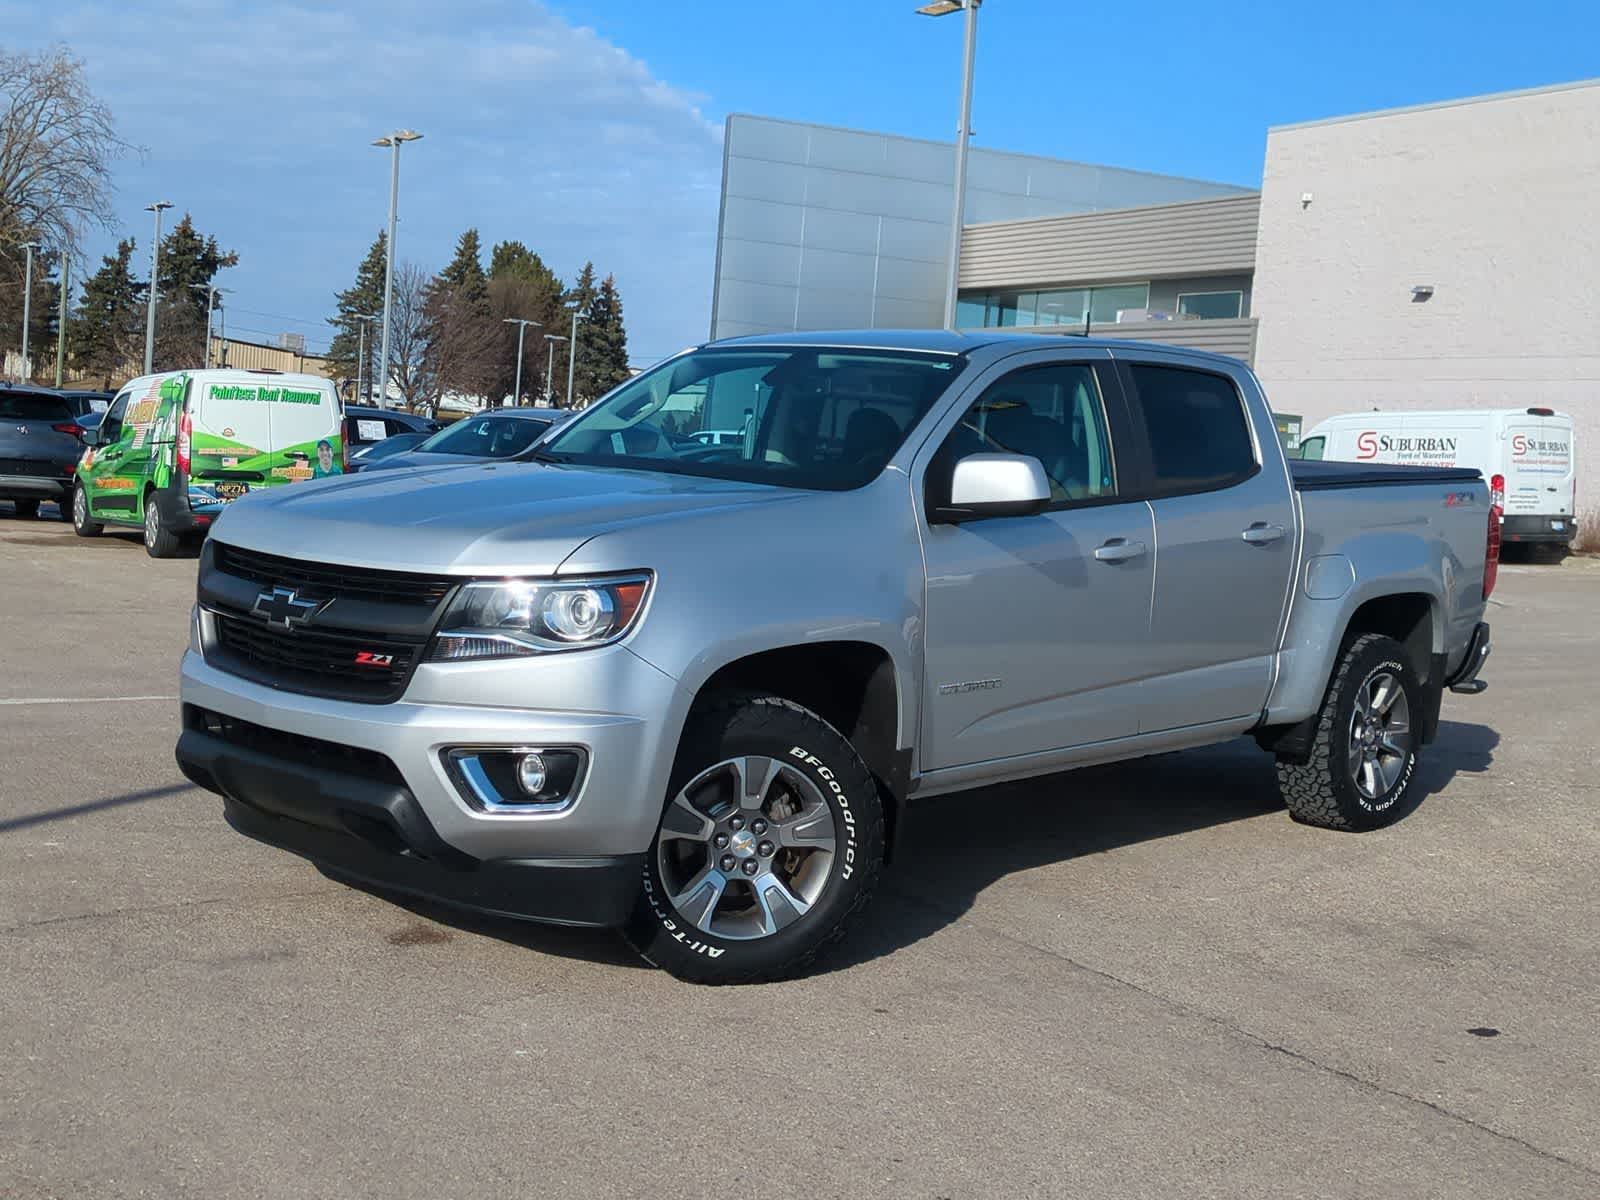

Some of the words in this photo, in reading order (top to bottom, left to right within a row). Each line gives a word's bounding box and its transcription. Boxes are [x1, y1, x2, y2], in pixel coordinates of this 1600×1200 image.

[209, 386, 257, 400] Paintless
[257, 387, 280, 402] Dent
[281, 389, 321, 405] Removal
[1379, 435, 1457, 451] SUBURBAN
[355, 652, 393, 665] Z71
[789, 746, 858, 880] BFGoodrich
[641, 863, 726, 958] All-Terrai
